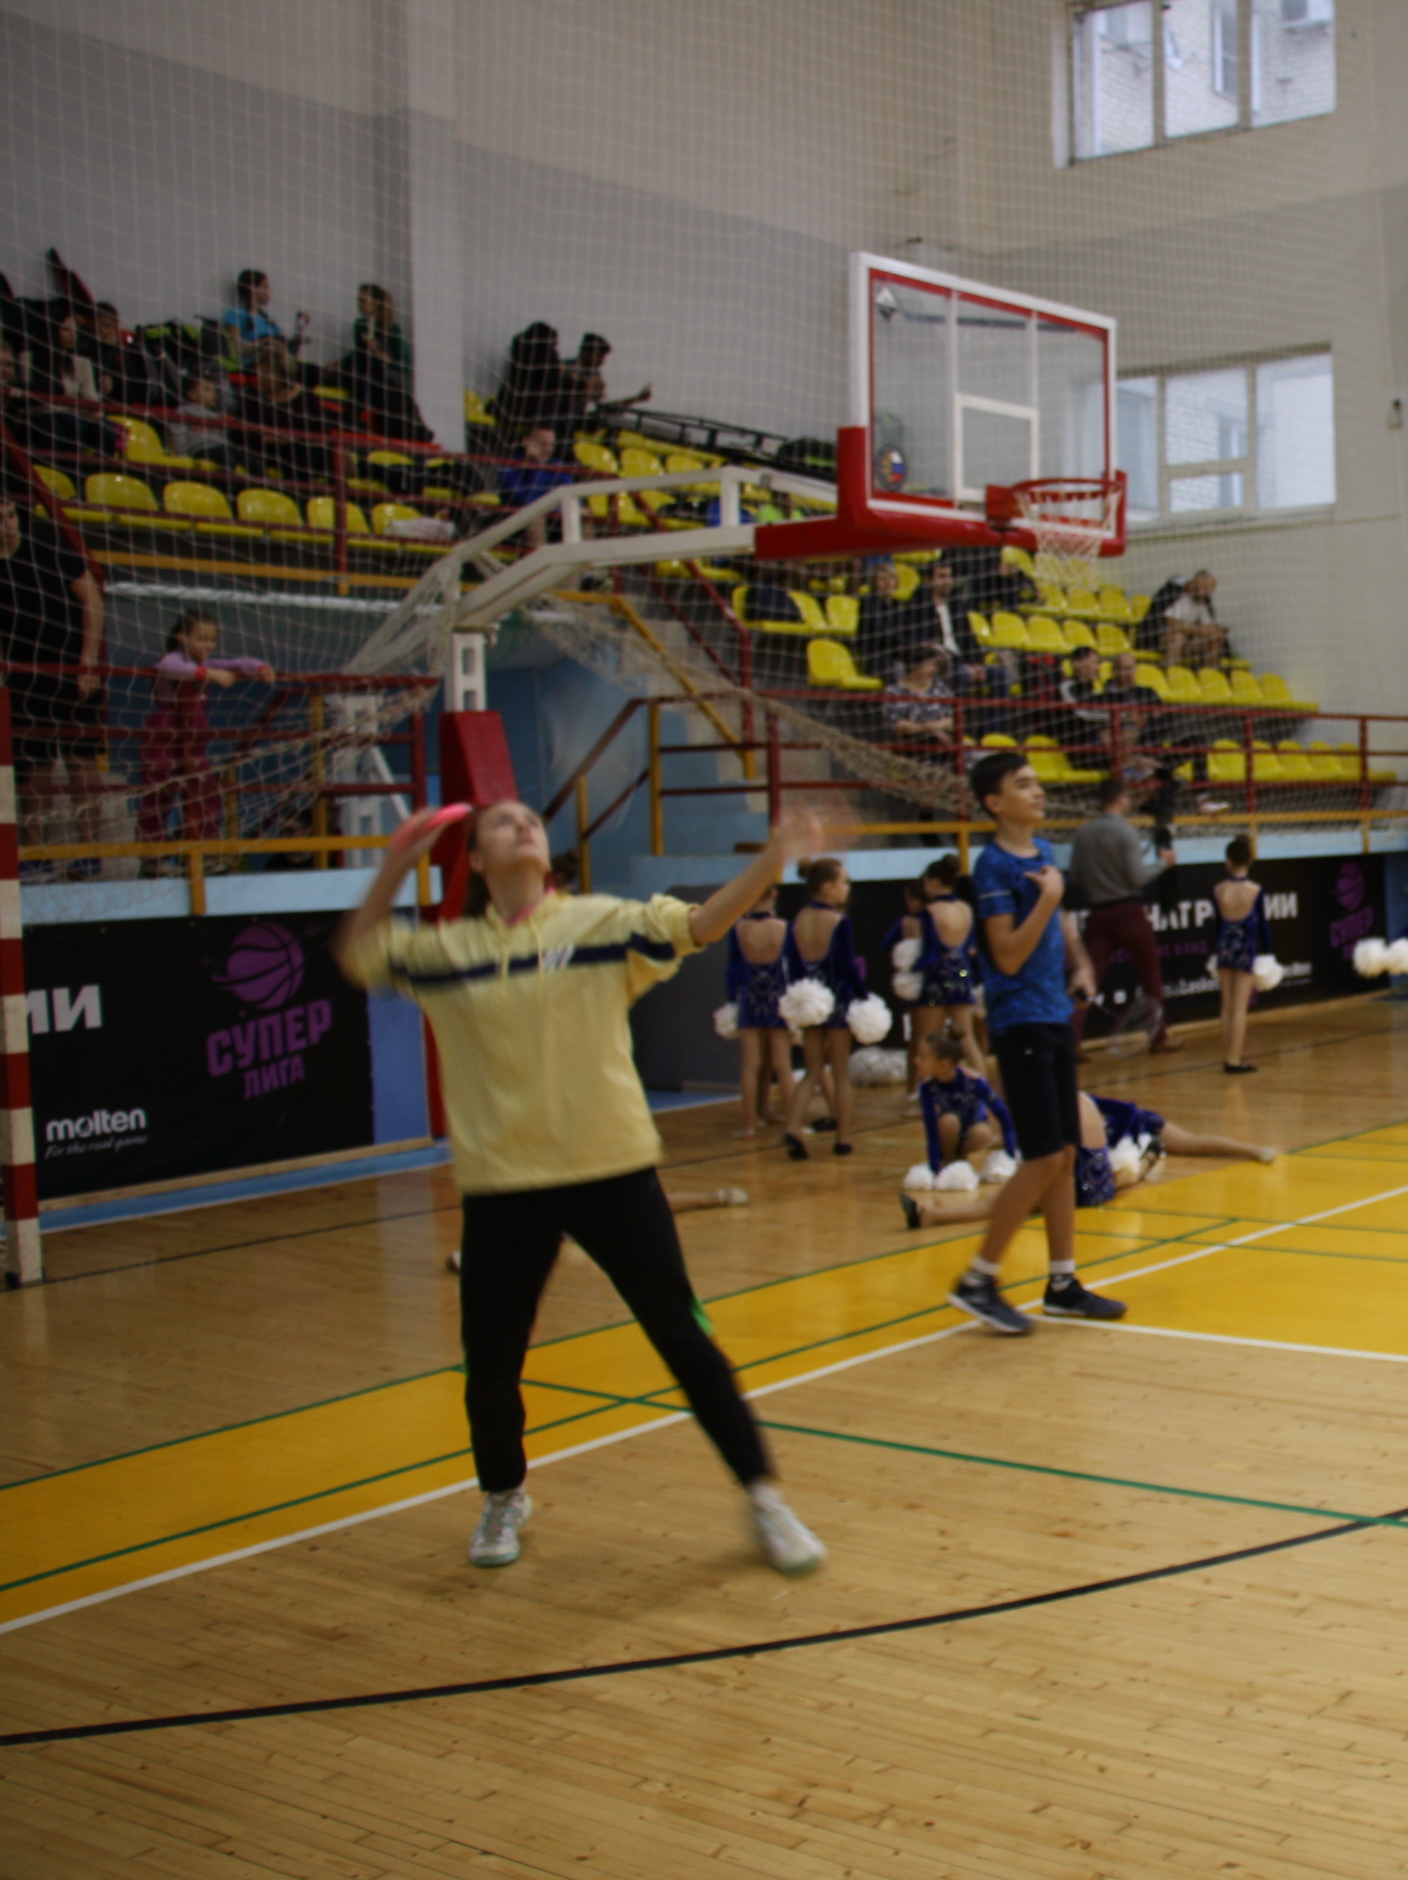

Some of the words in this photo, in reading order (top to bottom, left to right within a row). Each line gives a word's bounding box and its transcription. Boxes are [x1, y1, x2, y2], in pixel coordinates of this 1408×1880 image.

[206, 998, 333, 1078] СУПЕР
[243, 1053, 307, 1100] ЛИГА
[46, 1107, 147, 1142] molten
